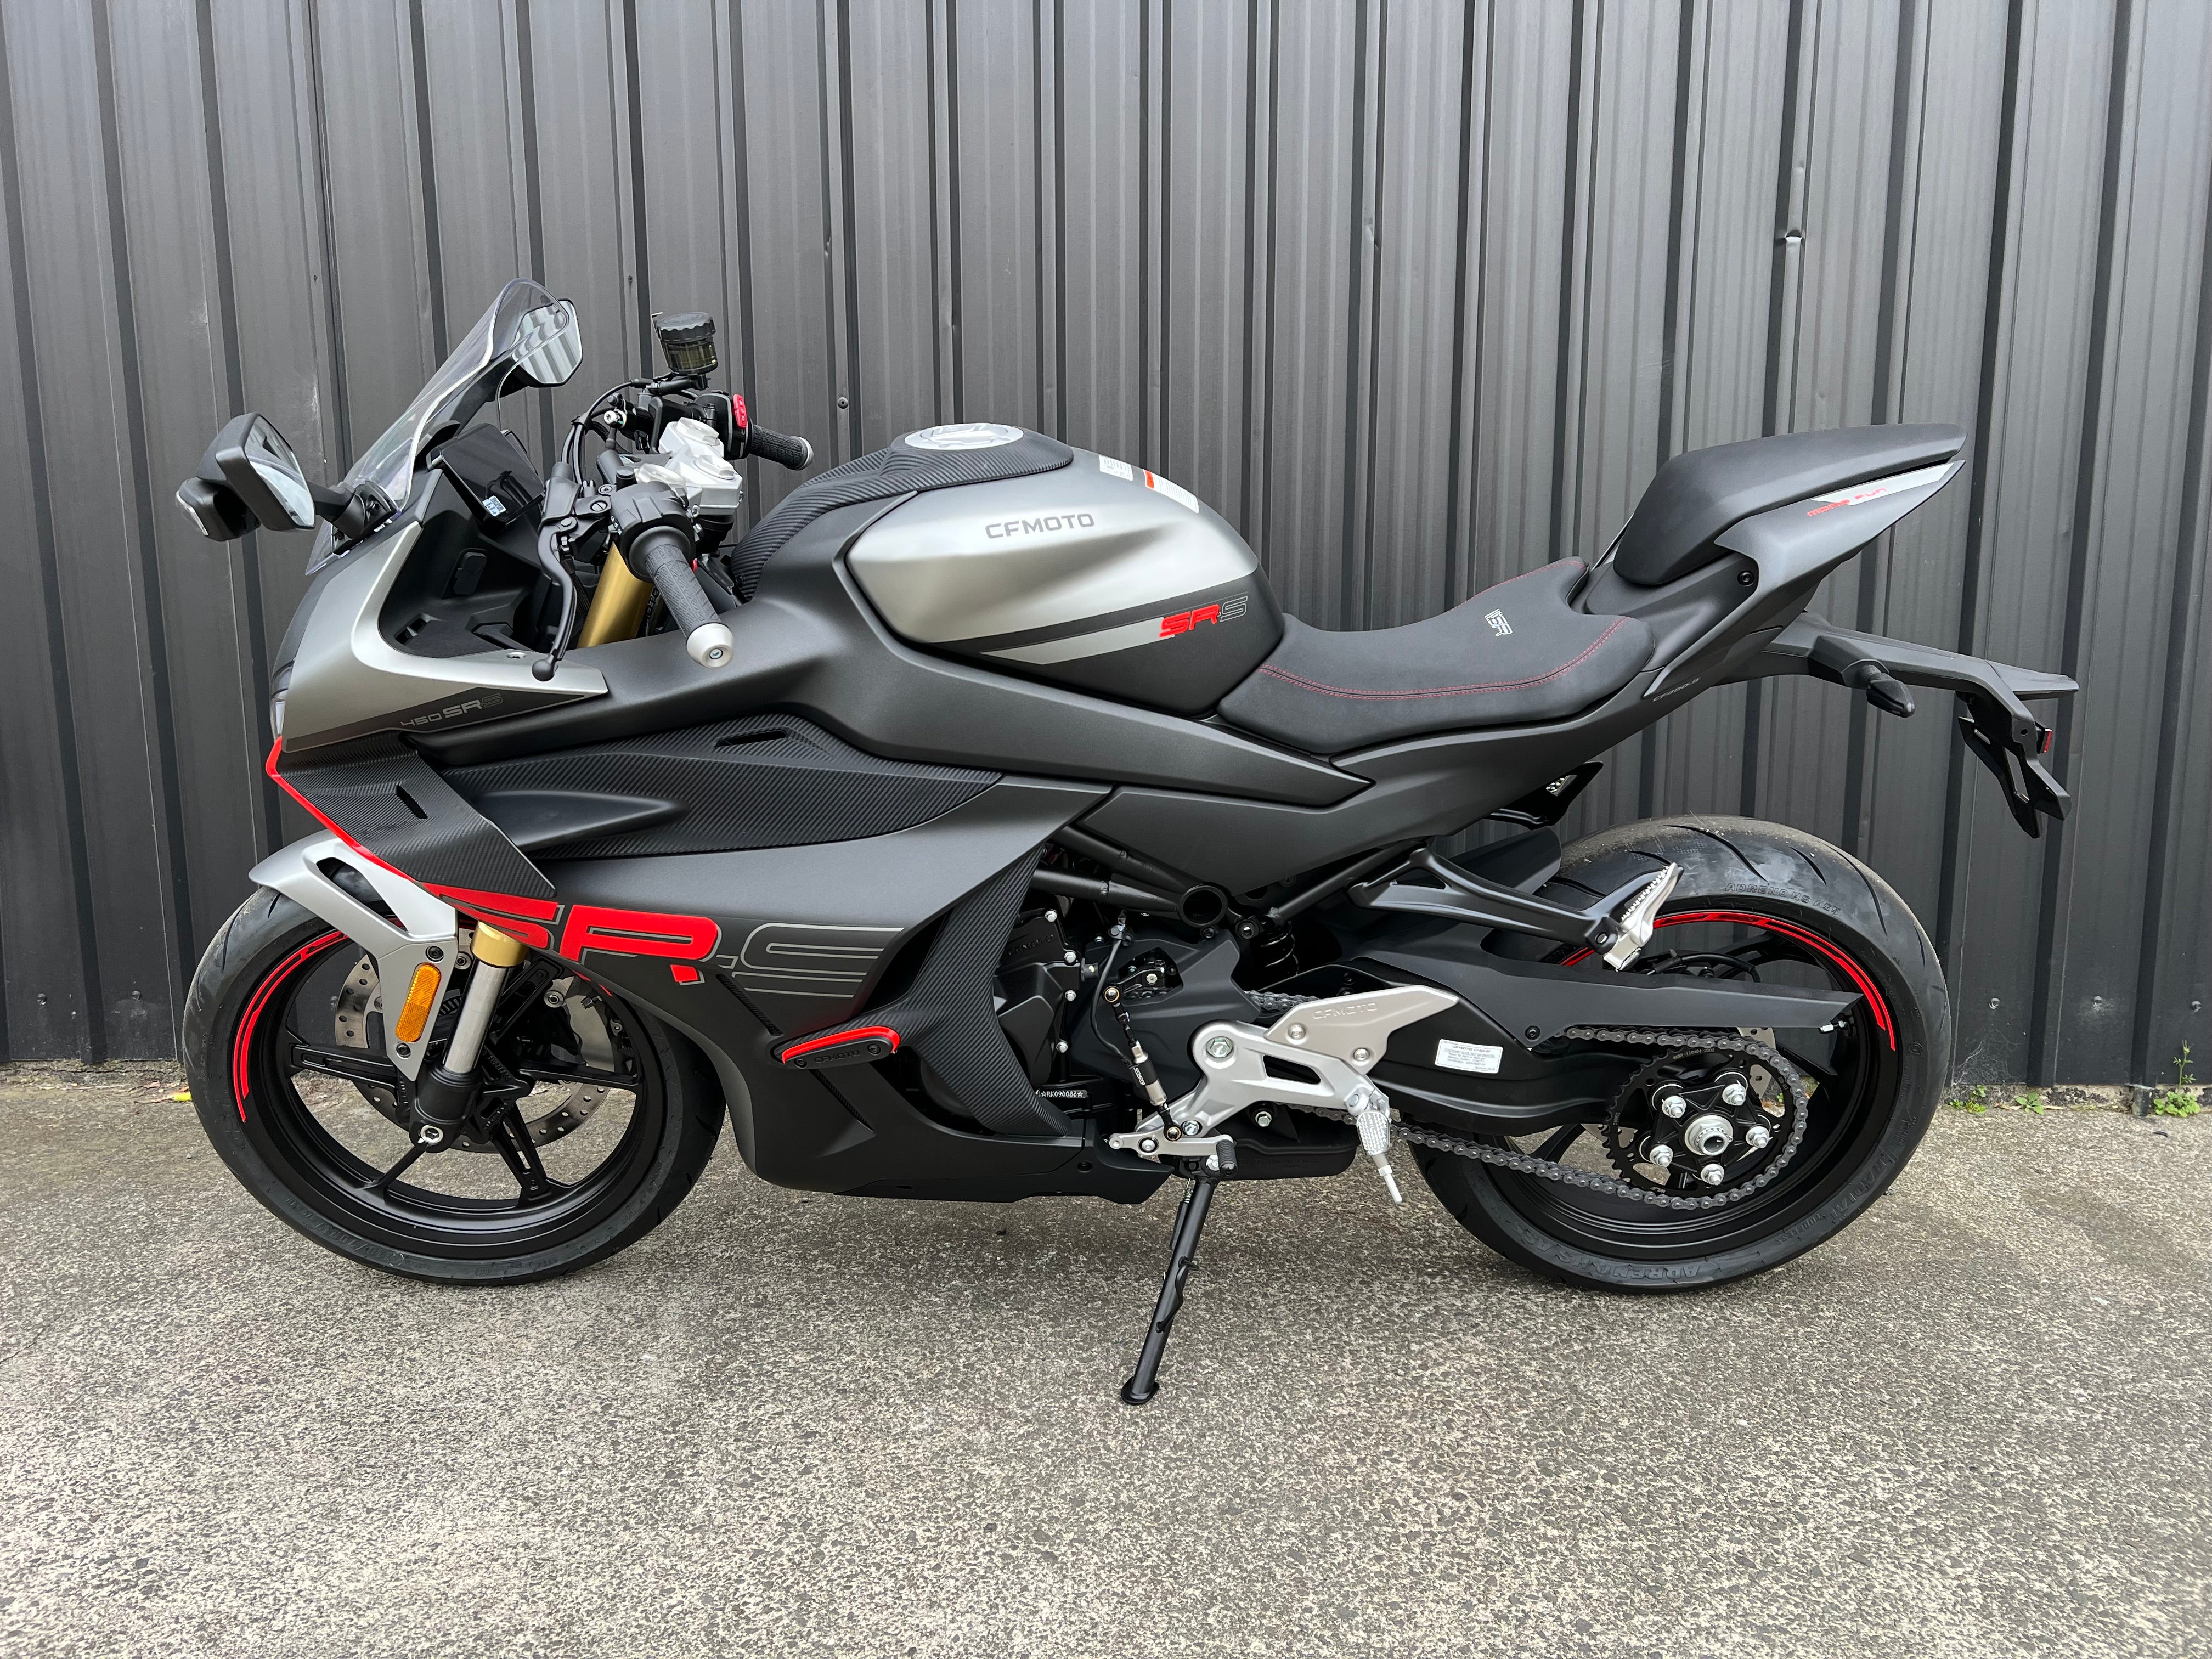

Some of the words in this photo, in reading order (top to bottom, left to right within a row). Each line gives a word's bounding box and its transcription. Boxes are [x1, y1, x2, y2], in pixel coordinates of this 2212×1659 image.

[985, 514, 1095, 539] CFMOTO
[1724, 883, 1788, 898] ADRENO
[1790, 891, 1811, 904] HS
[1313, 1002, 1378, 1019] CFMOTO
[814, 1049, 860, 1064] CFMOTO
[1596, 1263, 1700, 1280] ADRENO
